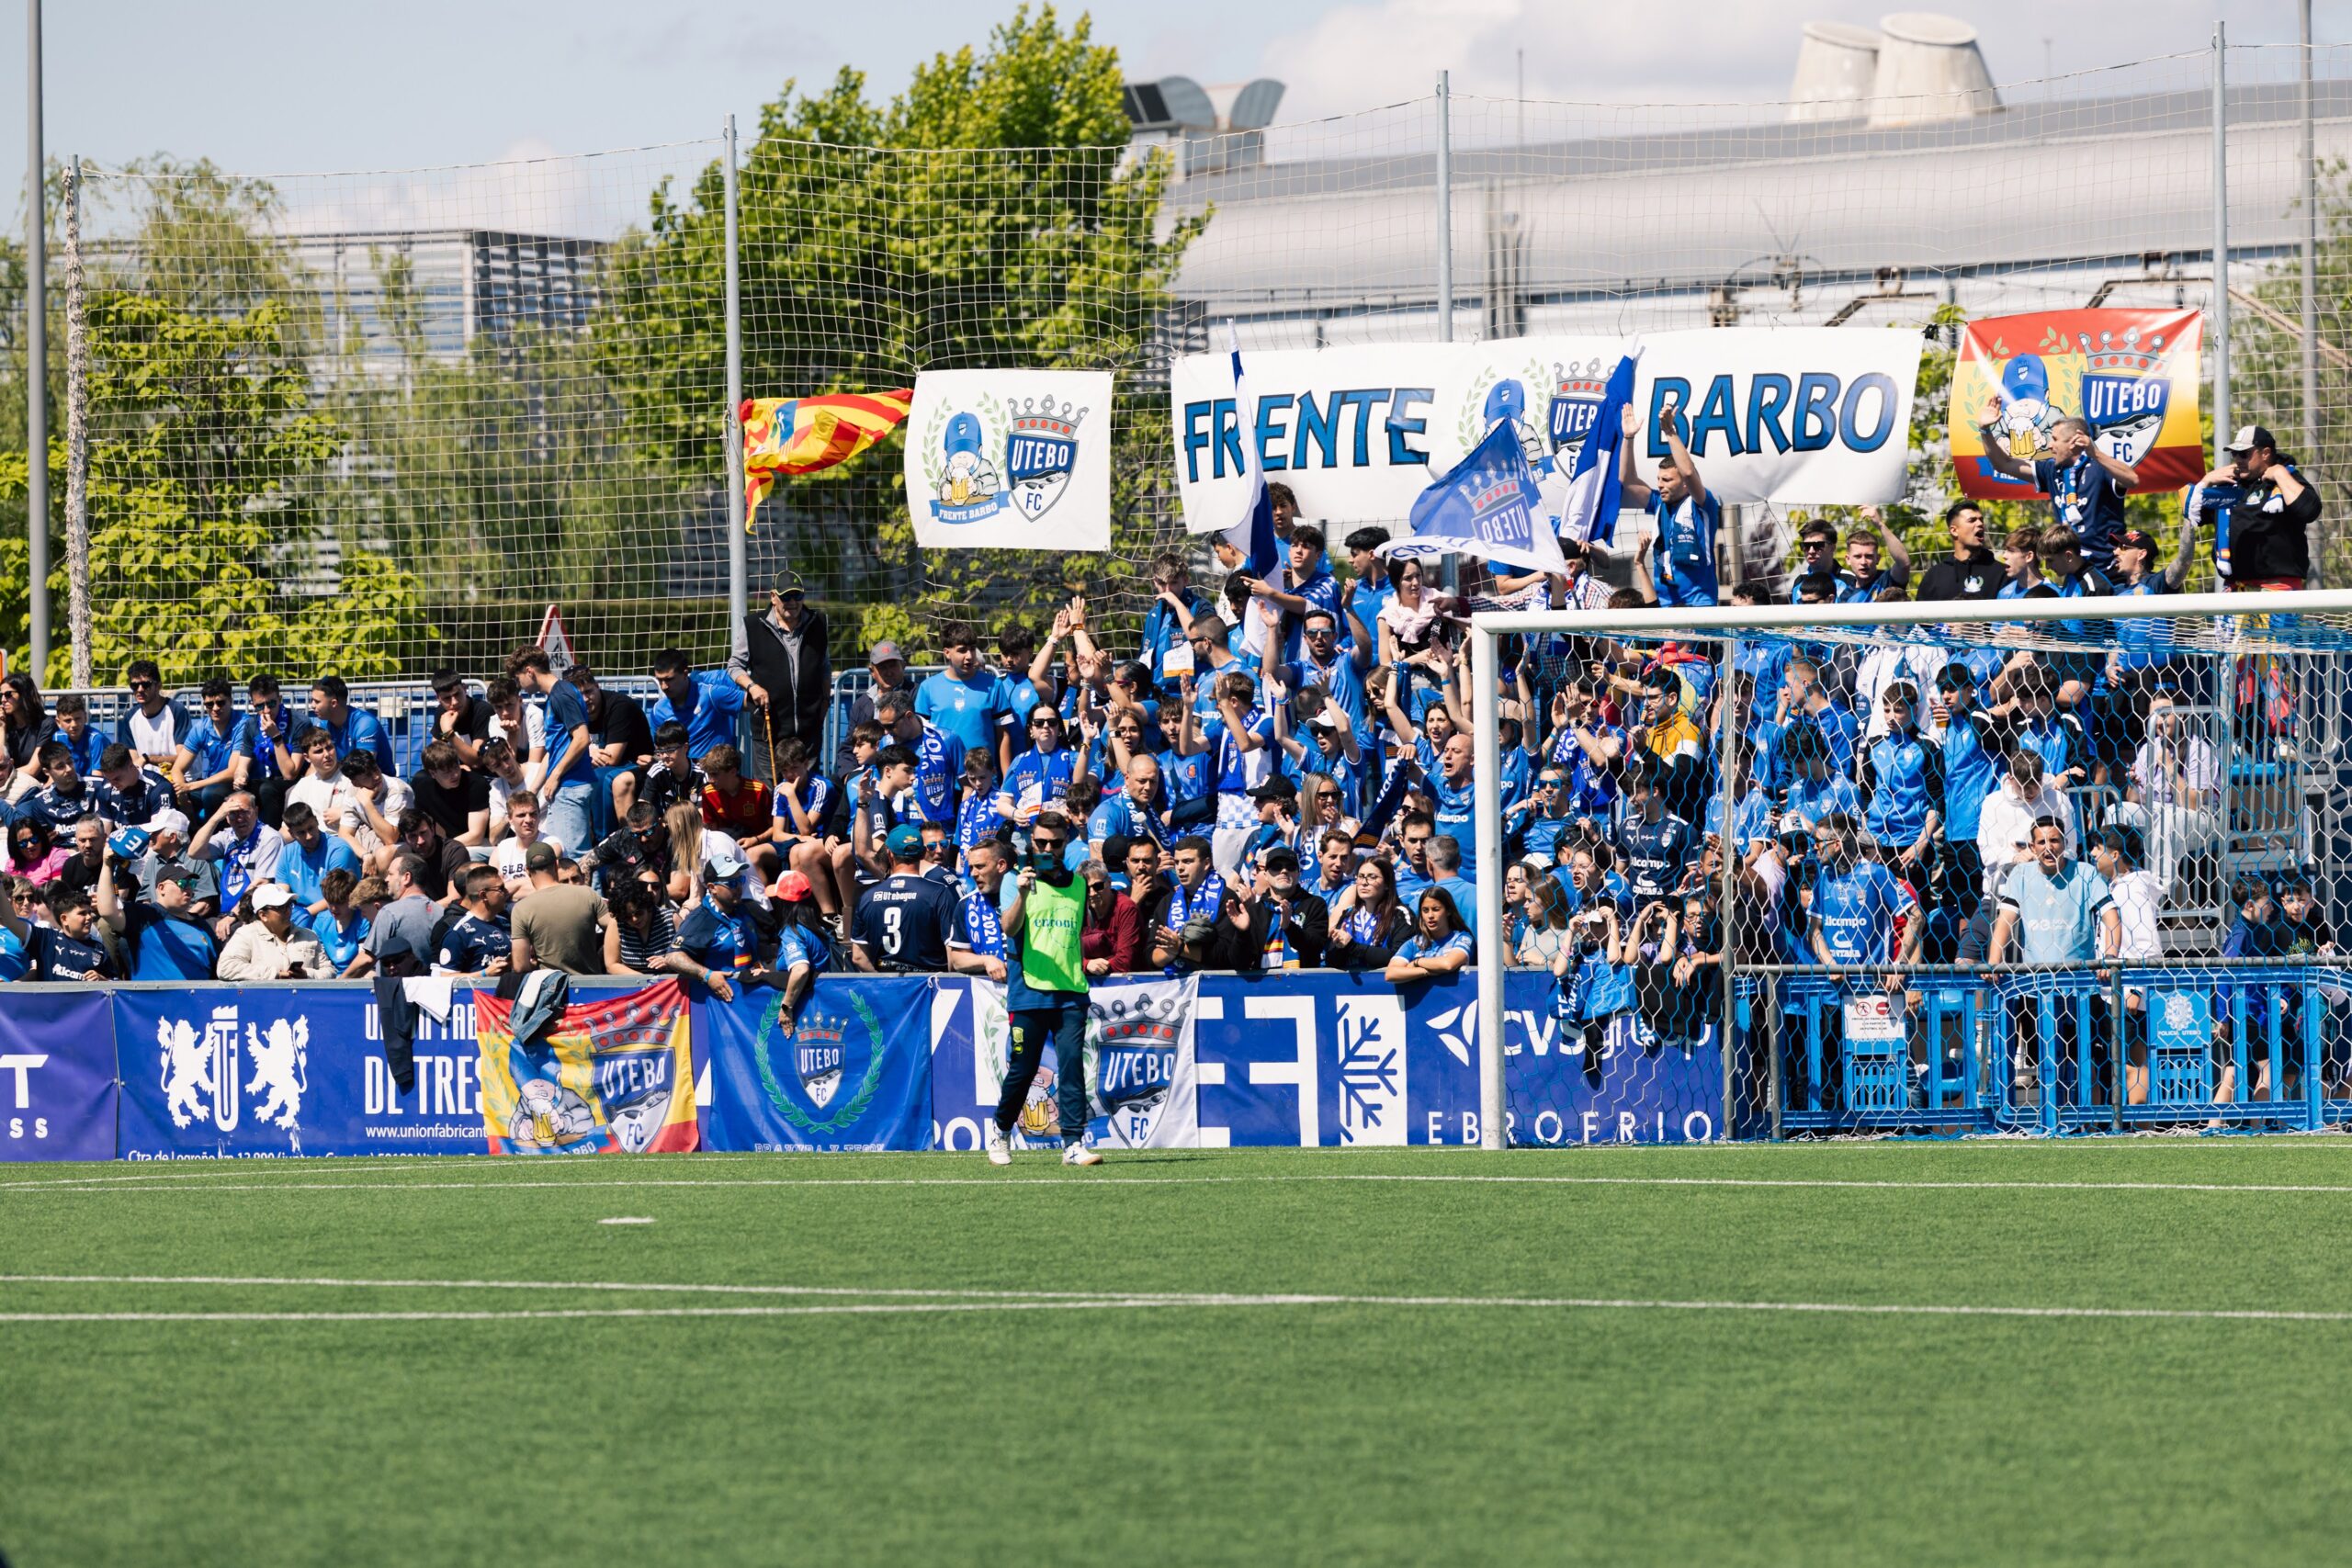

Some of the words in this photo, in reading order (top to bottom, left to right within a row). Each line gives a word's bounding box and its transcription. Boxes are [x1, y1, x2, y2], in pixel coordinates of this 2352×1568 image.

[1647, 372, 1898, 457] BARBO
[2089, 380, 2161, 419] UTEBO
[1554, 402, 1598, 435] UTEB
[1183, 387, 1435, 483] FRENTE
[1012, 439, 1069, 471] UTEBO
[2113, 443, 2132, 463] FC
[939, 508, 967, 521] FRENTE
[969, 502, 999, 519] BARBO
[1025, 492, 1042, 511] FC
[882, 907, 902, 955] 3
[982, 912, 999, 944] 2024
[800, 1048, 839, 1074] UTEBO
[1104, 1052, 1174, 1092] UTEBO
[602, 1056, 666, 1100] UTEBO
[816, 1087, 827, 1102] FC
[626, 1123, 644, 1145] FC
[1130, 1116, 1149, 1141] FC
